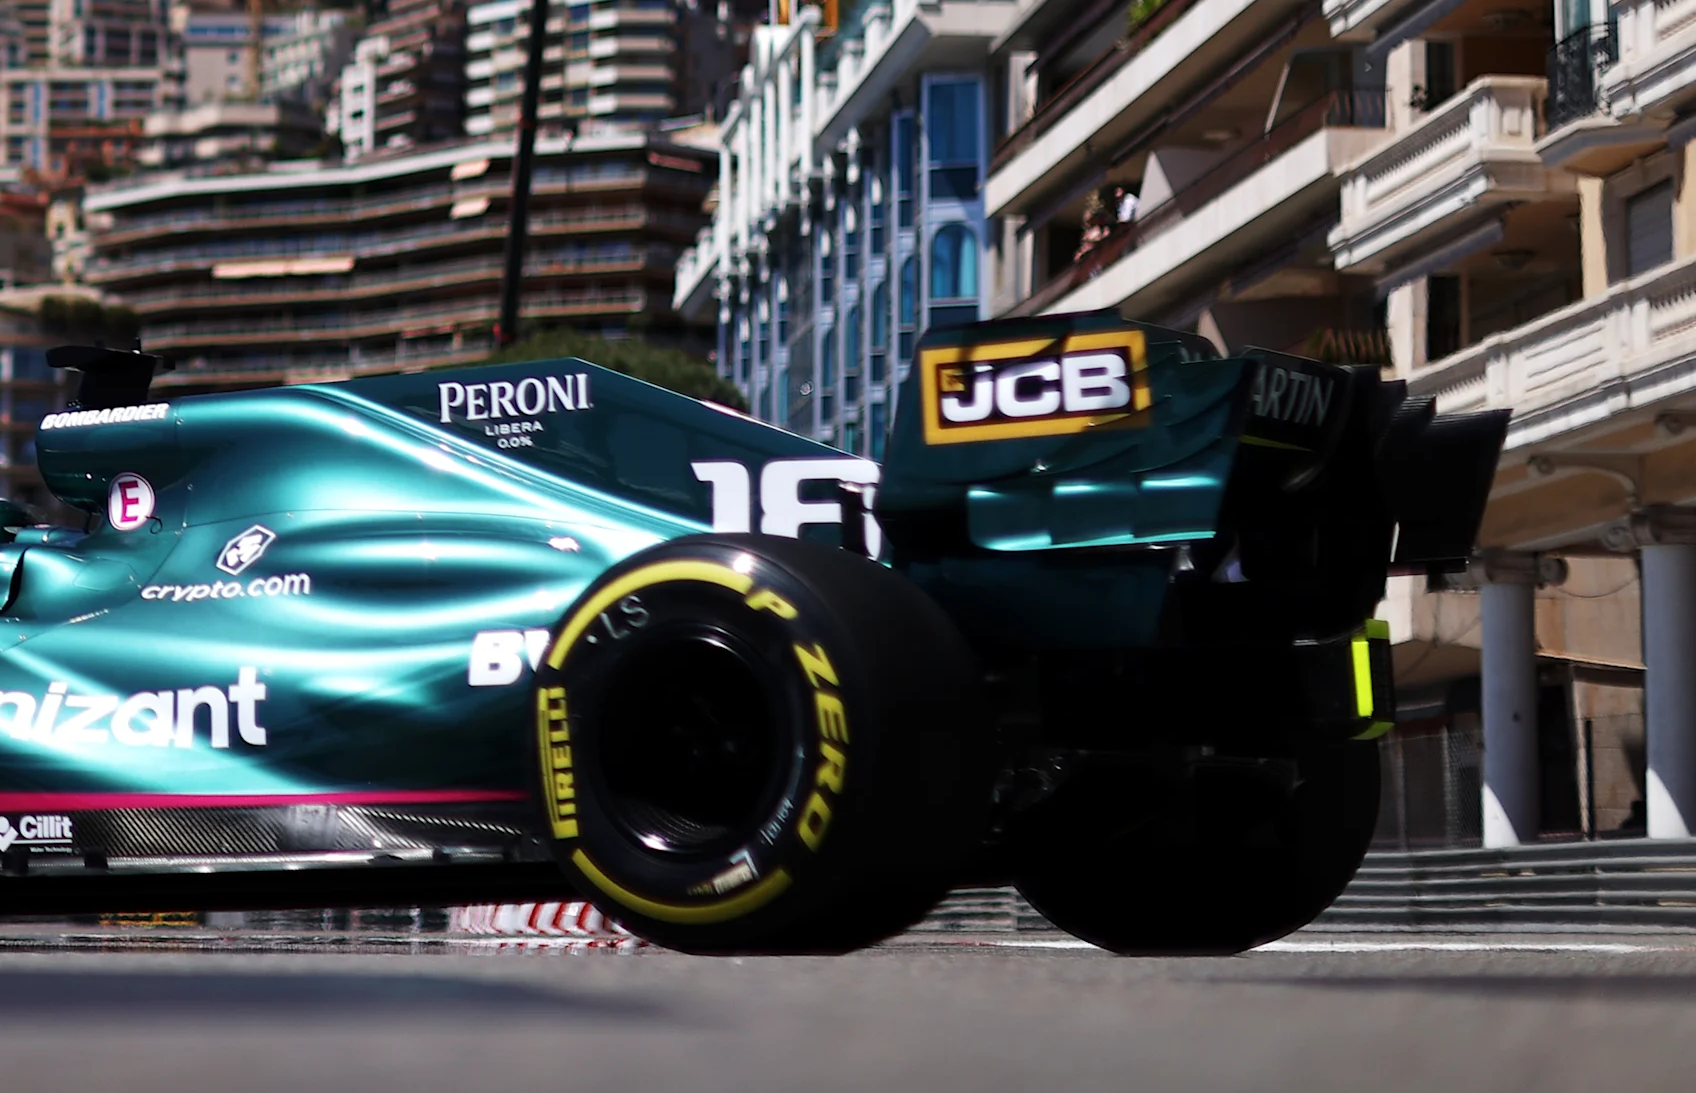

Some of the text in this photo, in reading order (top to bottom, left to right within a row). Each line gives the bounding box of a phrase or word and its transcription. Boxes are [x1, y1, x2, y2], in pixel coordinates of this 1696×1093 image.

[438, 373, 589, 423] PERONI
[941, 353, 1130, 423] JCB
[1252, 365, 1334, 428] ARTIN
[40, 403, 170, 430] BOMBARDIER
[484, 421, 544, 437] LIBERA
[118, 480, 139, 523] E
[140, 572, 311, 602] crypto.com
[536, 686, 580, 840] PIRELLI
[793, 642, 849, 852] ZERO
[20, 815, 73, 839] Cillit
